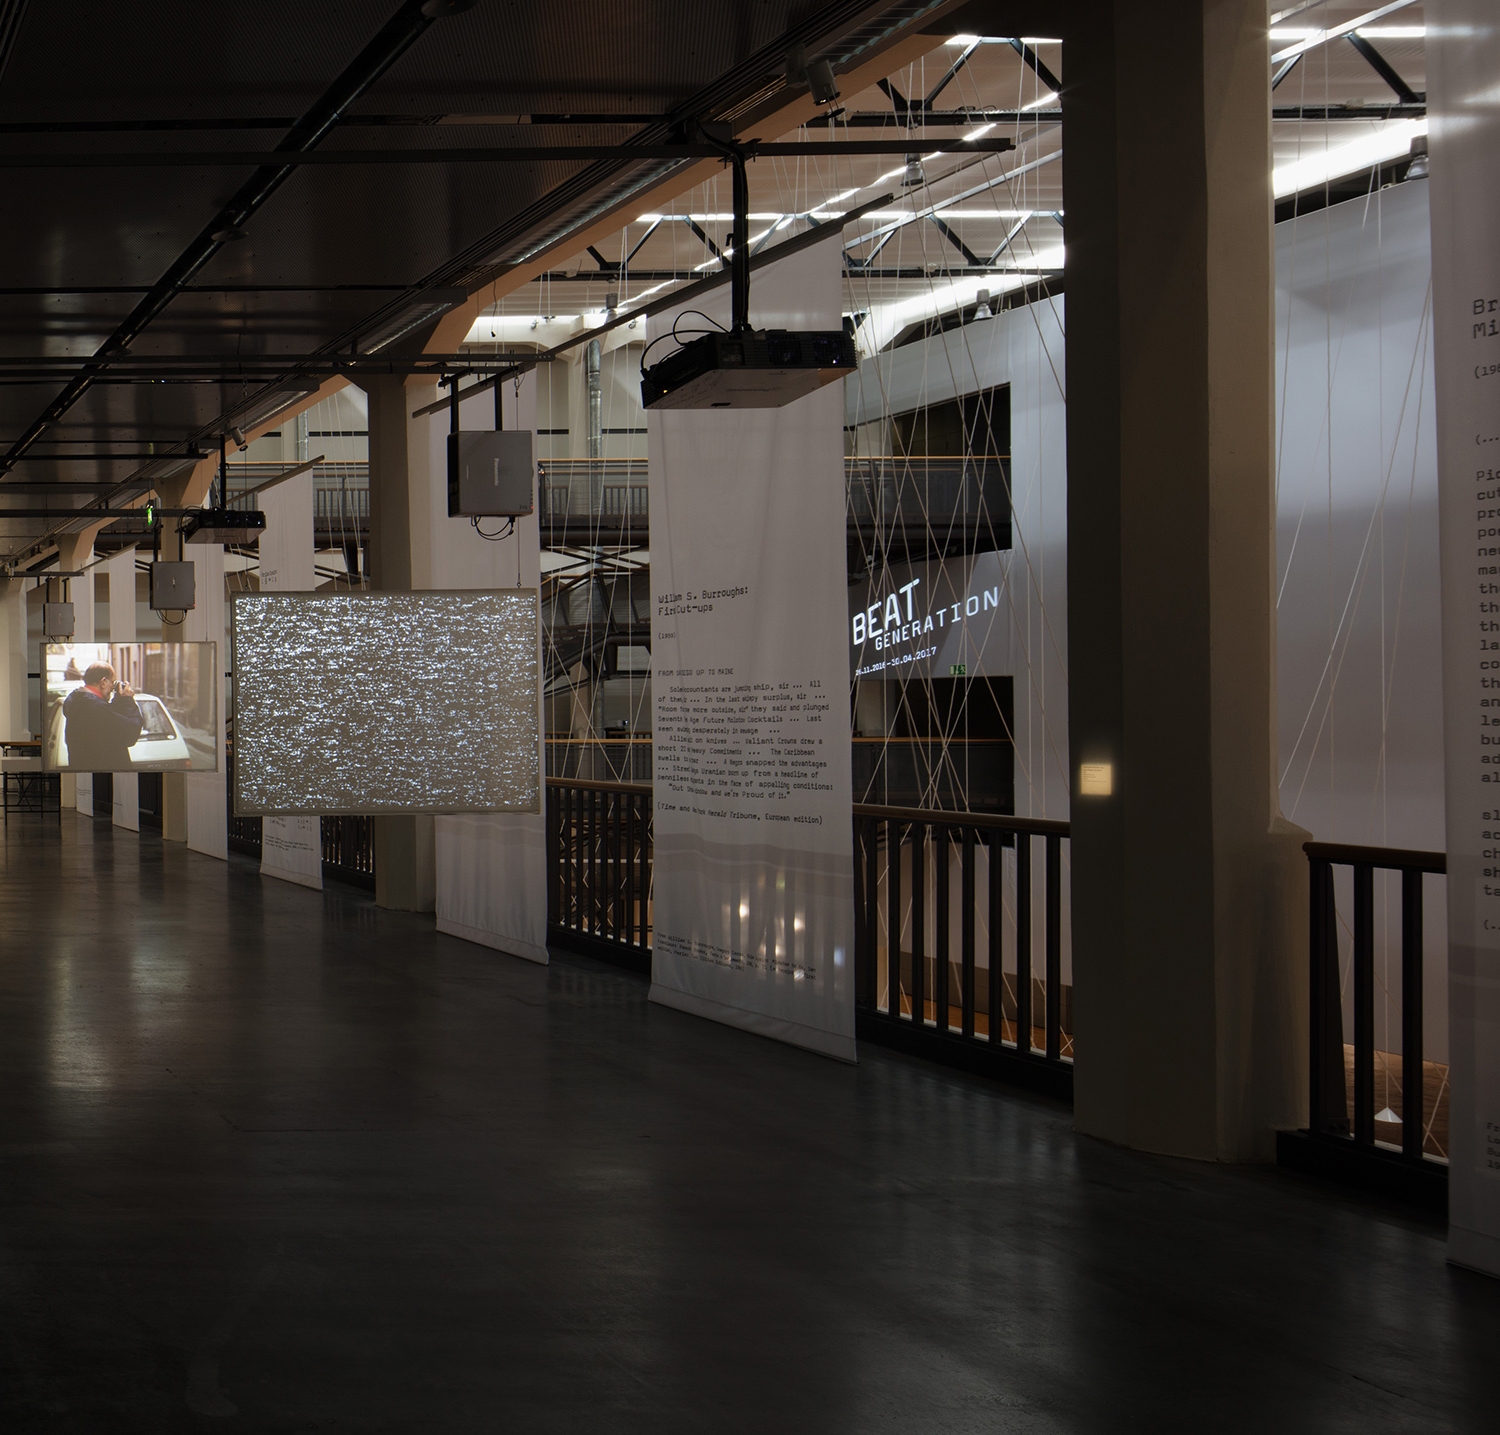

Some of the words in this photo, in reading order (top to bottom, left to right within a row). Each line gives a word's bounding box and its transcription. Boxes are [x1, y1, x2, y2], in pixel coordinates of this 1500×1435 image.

[1473, 298, 1500, 315] Br
[1478, 566, 1500, 576] ma
[687, 592, 697, 601] S.
[702, 586, 748, 599] Burroughs:
[853, 578, 920, 645] BEAT
[875, 586, 998, 650] GENERATION
[658, 669, 674, 677] FROM
[809, 680, 821, 688] All
[751, 705, 767, 713] they
[803, 703, 829, 712] plunged
